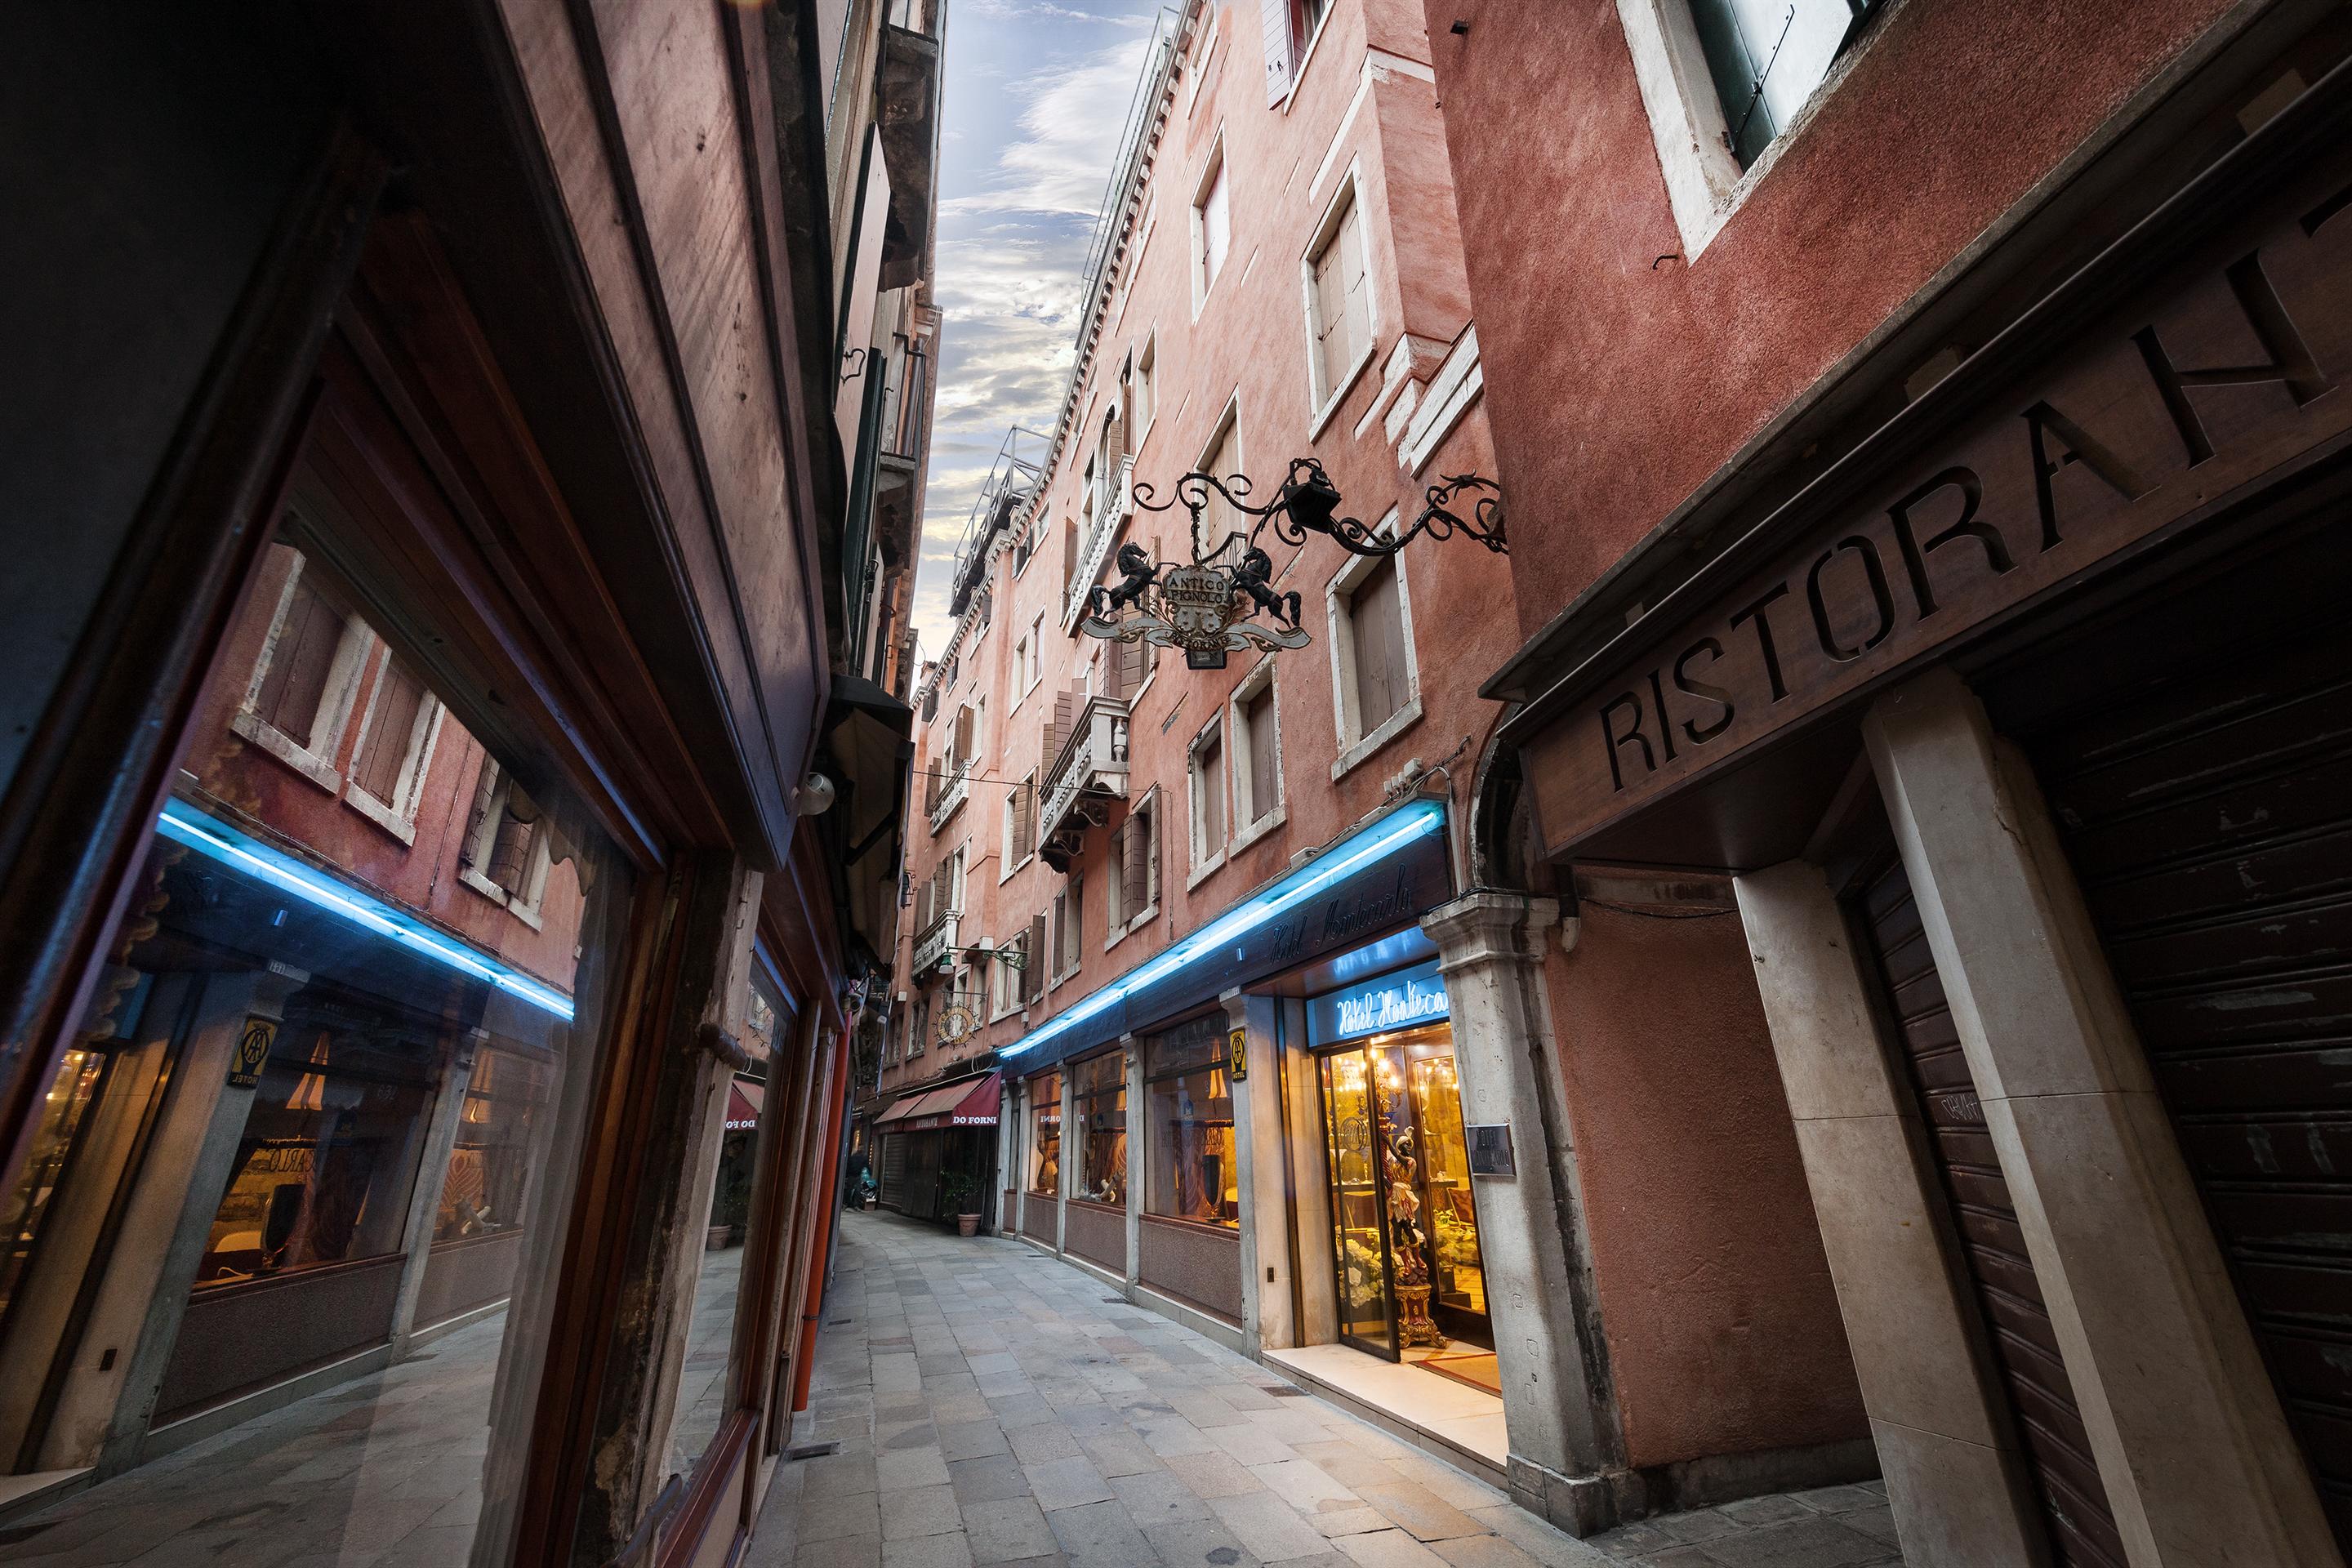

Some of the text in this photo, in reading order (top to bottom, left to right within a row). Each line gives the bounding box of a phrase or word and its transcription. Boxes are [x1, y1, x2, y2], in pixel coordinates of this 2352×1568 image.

[1169, 577, 1224, 590] ANTICO
[1171, 590, 1223, 604] PIGNOLO
[1270, 914, 1307, 964] Hotel
[1314, 862, 1411, 948] Montecarlo
[1337, 992, 1375, 1036] Hotel
[1232, 1071, 1245, 1080] HOTEL
[953, 1116, 997, 1125] DO FORNI
